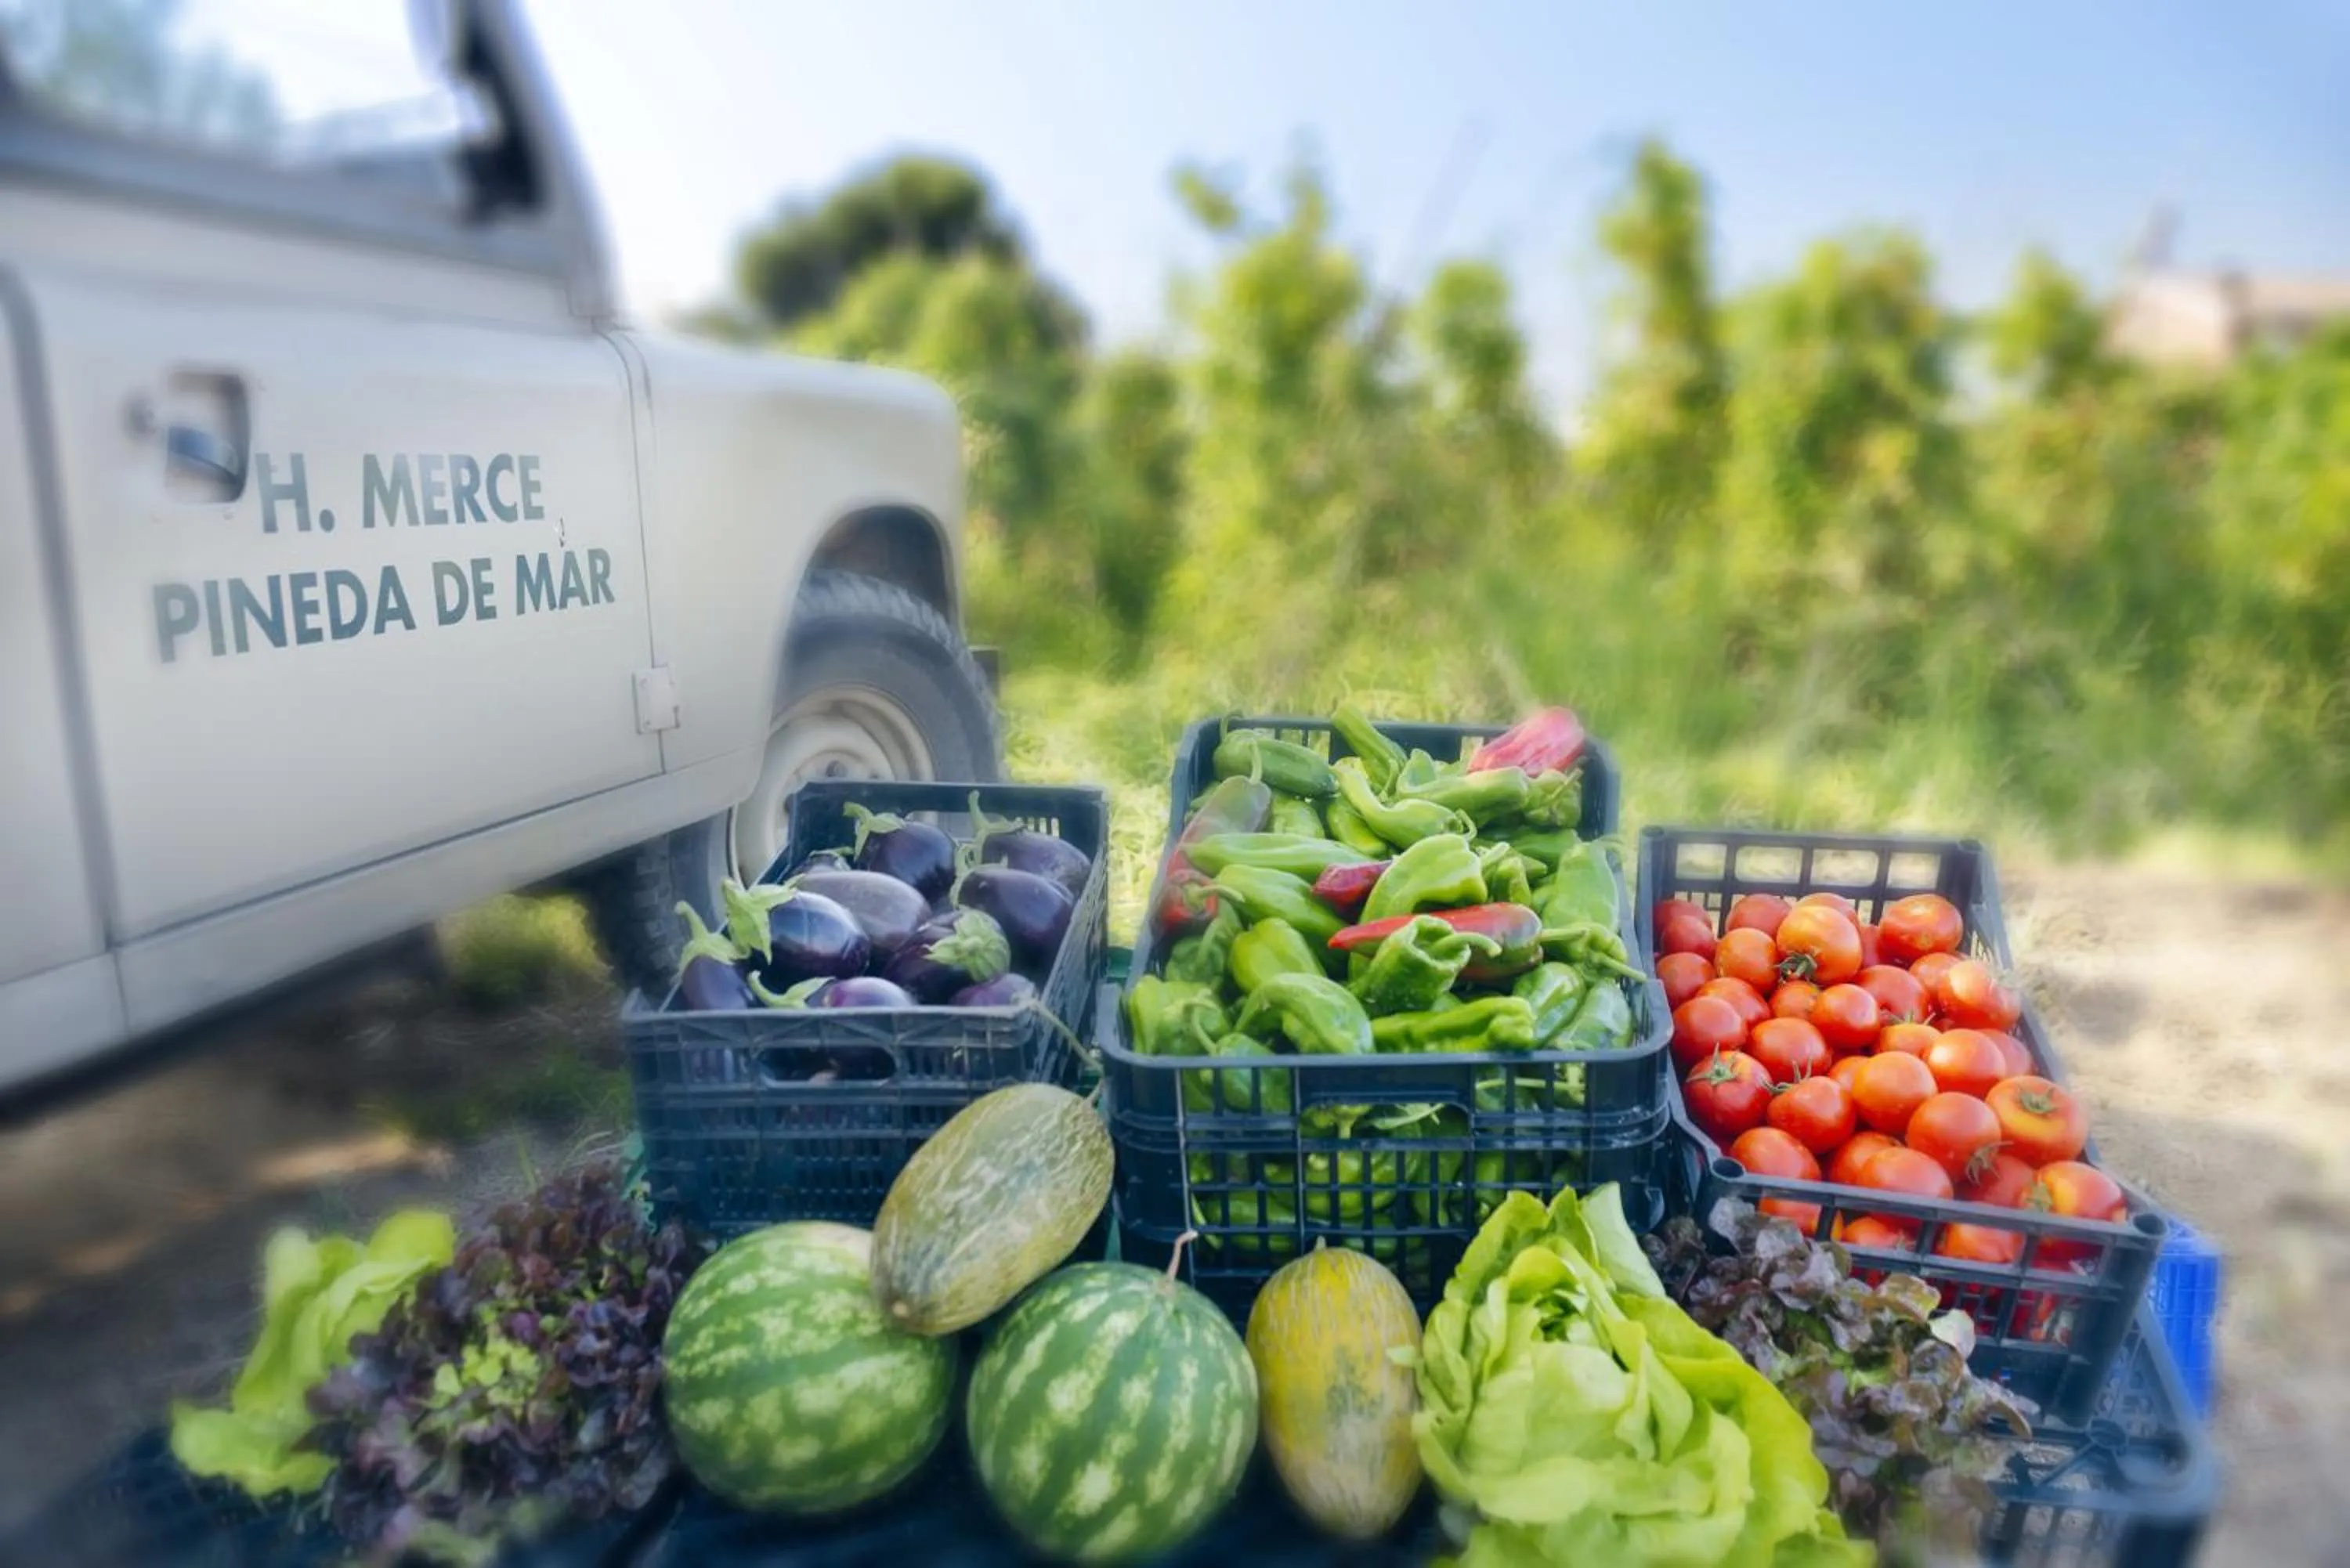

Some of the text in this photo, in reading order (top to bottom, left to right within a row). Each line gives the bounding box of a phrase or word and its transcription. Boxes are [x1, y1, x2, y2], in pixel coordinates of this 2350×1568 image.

[256, 453, 545, 533] H. MERCE
[153, 548, 615, 663] PINEDA DE MAR
